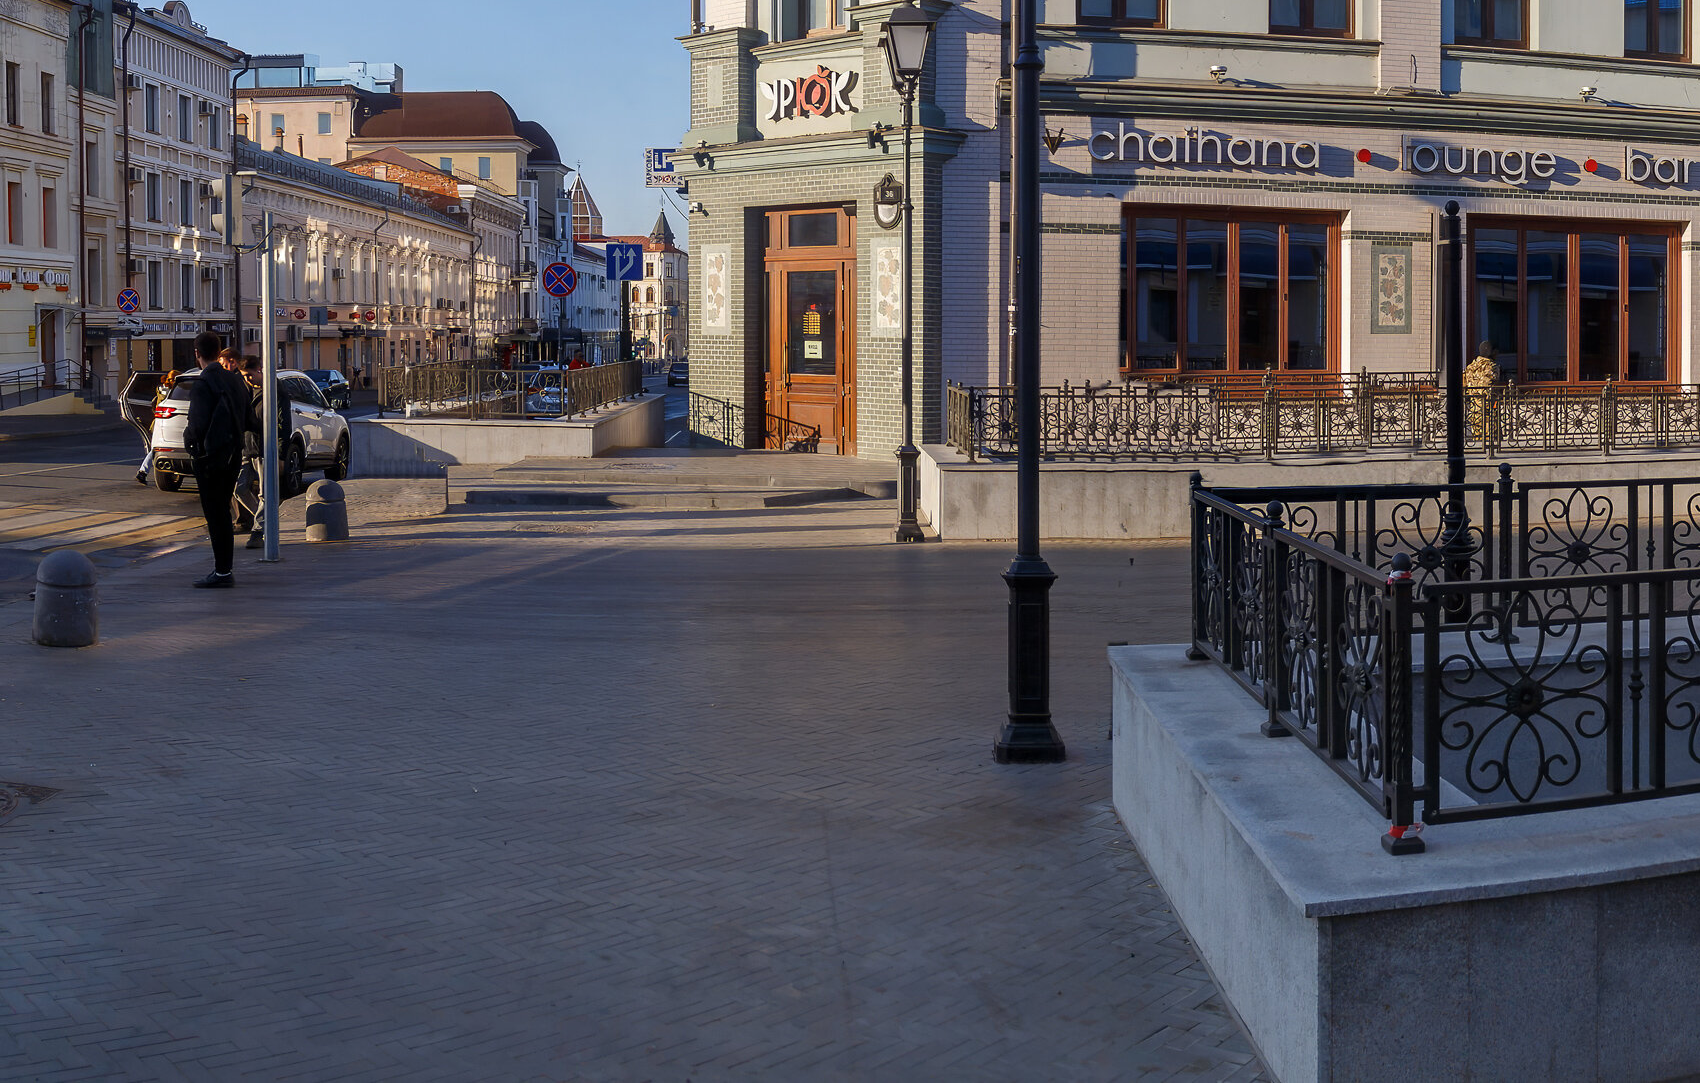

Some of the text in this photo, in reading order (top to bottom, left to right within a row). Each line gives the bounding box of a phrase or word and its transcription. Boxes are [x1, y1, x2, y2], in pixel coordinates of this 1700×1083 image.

[759, 65, 851, 120] УРЮК
[1087, 121, 1697, 186] chaihana lounge bar
